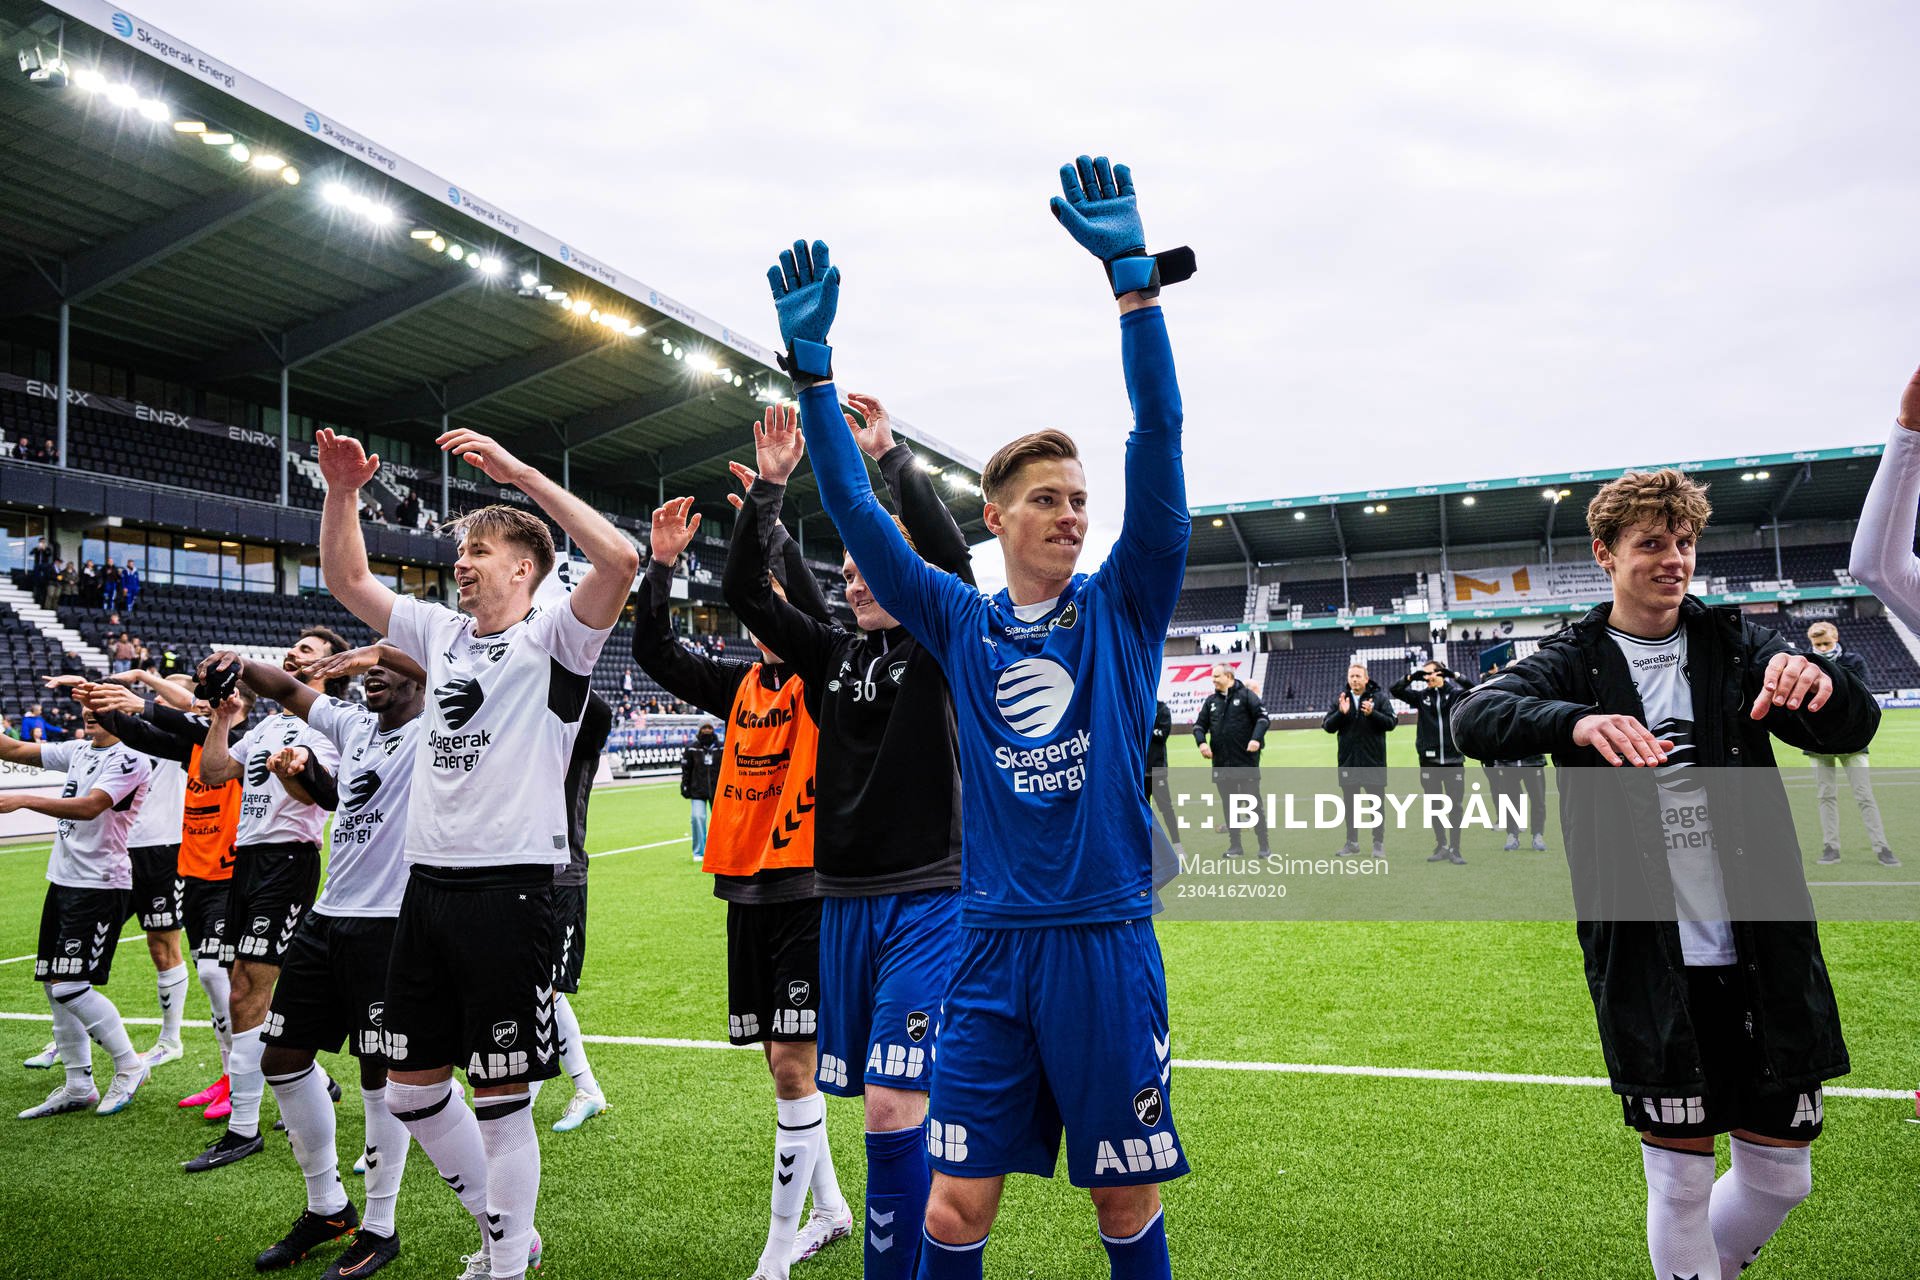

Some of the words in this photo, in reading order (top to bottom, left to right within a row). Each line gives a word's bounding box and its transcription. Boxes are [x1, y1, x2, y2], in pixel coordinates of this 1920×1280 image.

[137, 28, 195, 67] Skagerak
[198, 59, 235, 88] Energi
[135, 405, 190, 429] ENRX
[228, 426, 279, 449] ENRX
[381, 461, 420, 480] ENRX
[853, 680, 877, 702] 30
[433, 750, 480, 772] Energi
[995, 730, 1091, 770] Skagerak
[1014, 758, 1086, 793] Energi
[724, 784, 743, 801] EN
[746, 783, 785, 801] Grafis
[143, 912, 174, 928] ABB
[728, 1013, 760, 1038] BB
[772, 1009, 817, 1035] ABB
[467, 1050, 529, 1079] ABB
[819, 1053, 848, 1088] BB
[866, 1043, 925, 1078] ABB
[926, 1118, 968, 1163] BB
[1094, 1131, 1180, 1175] ABB
